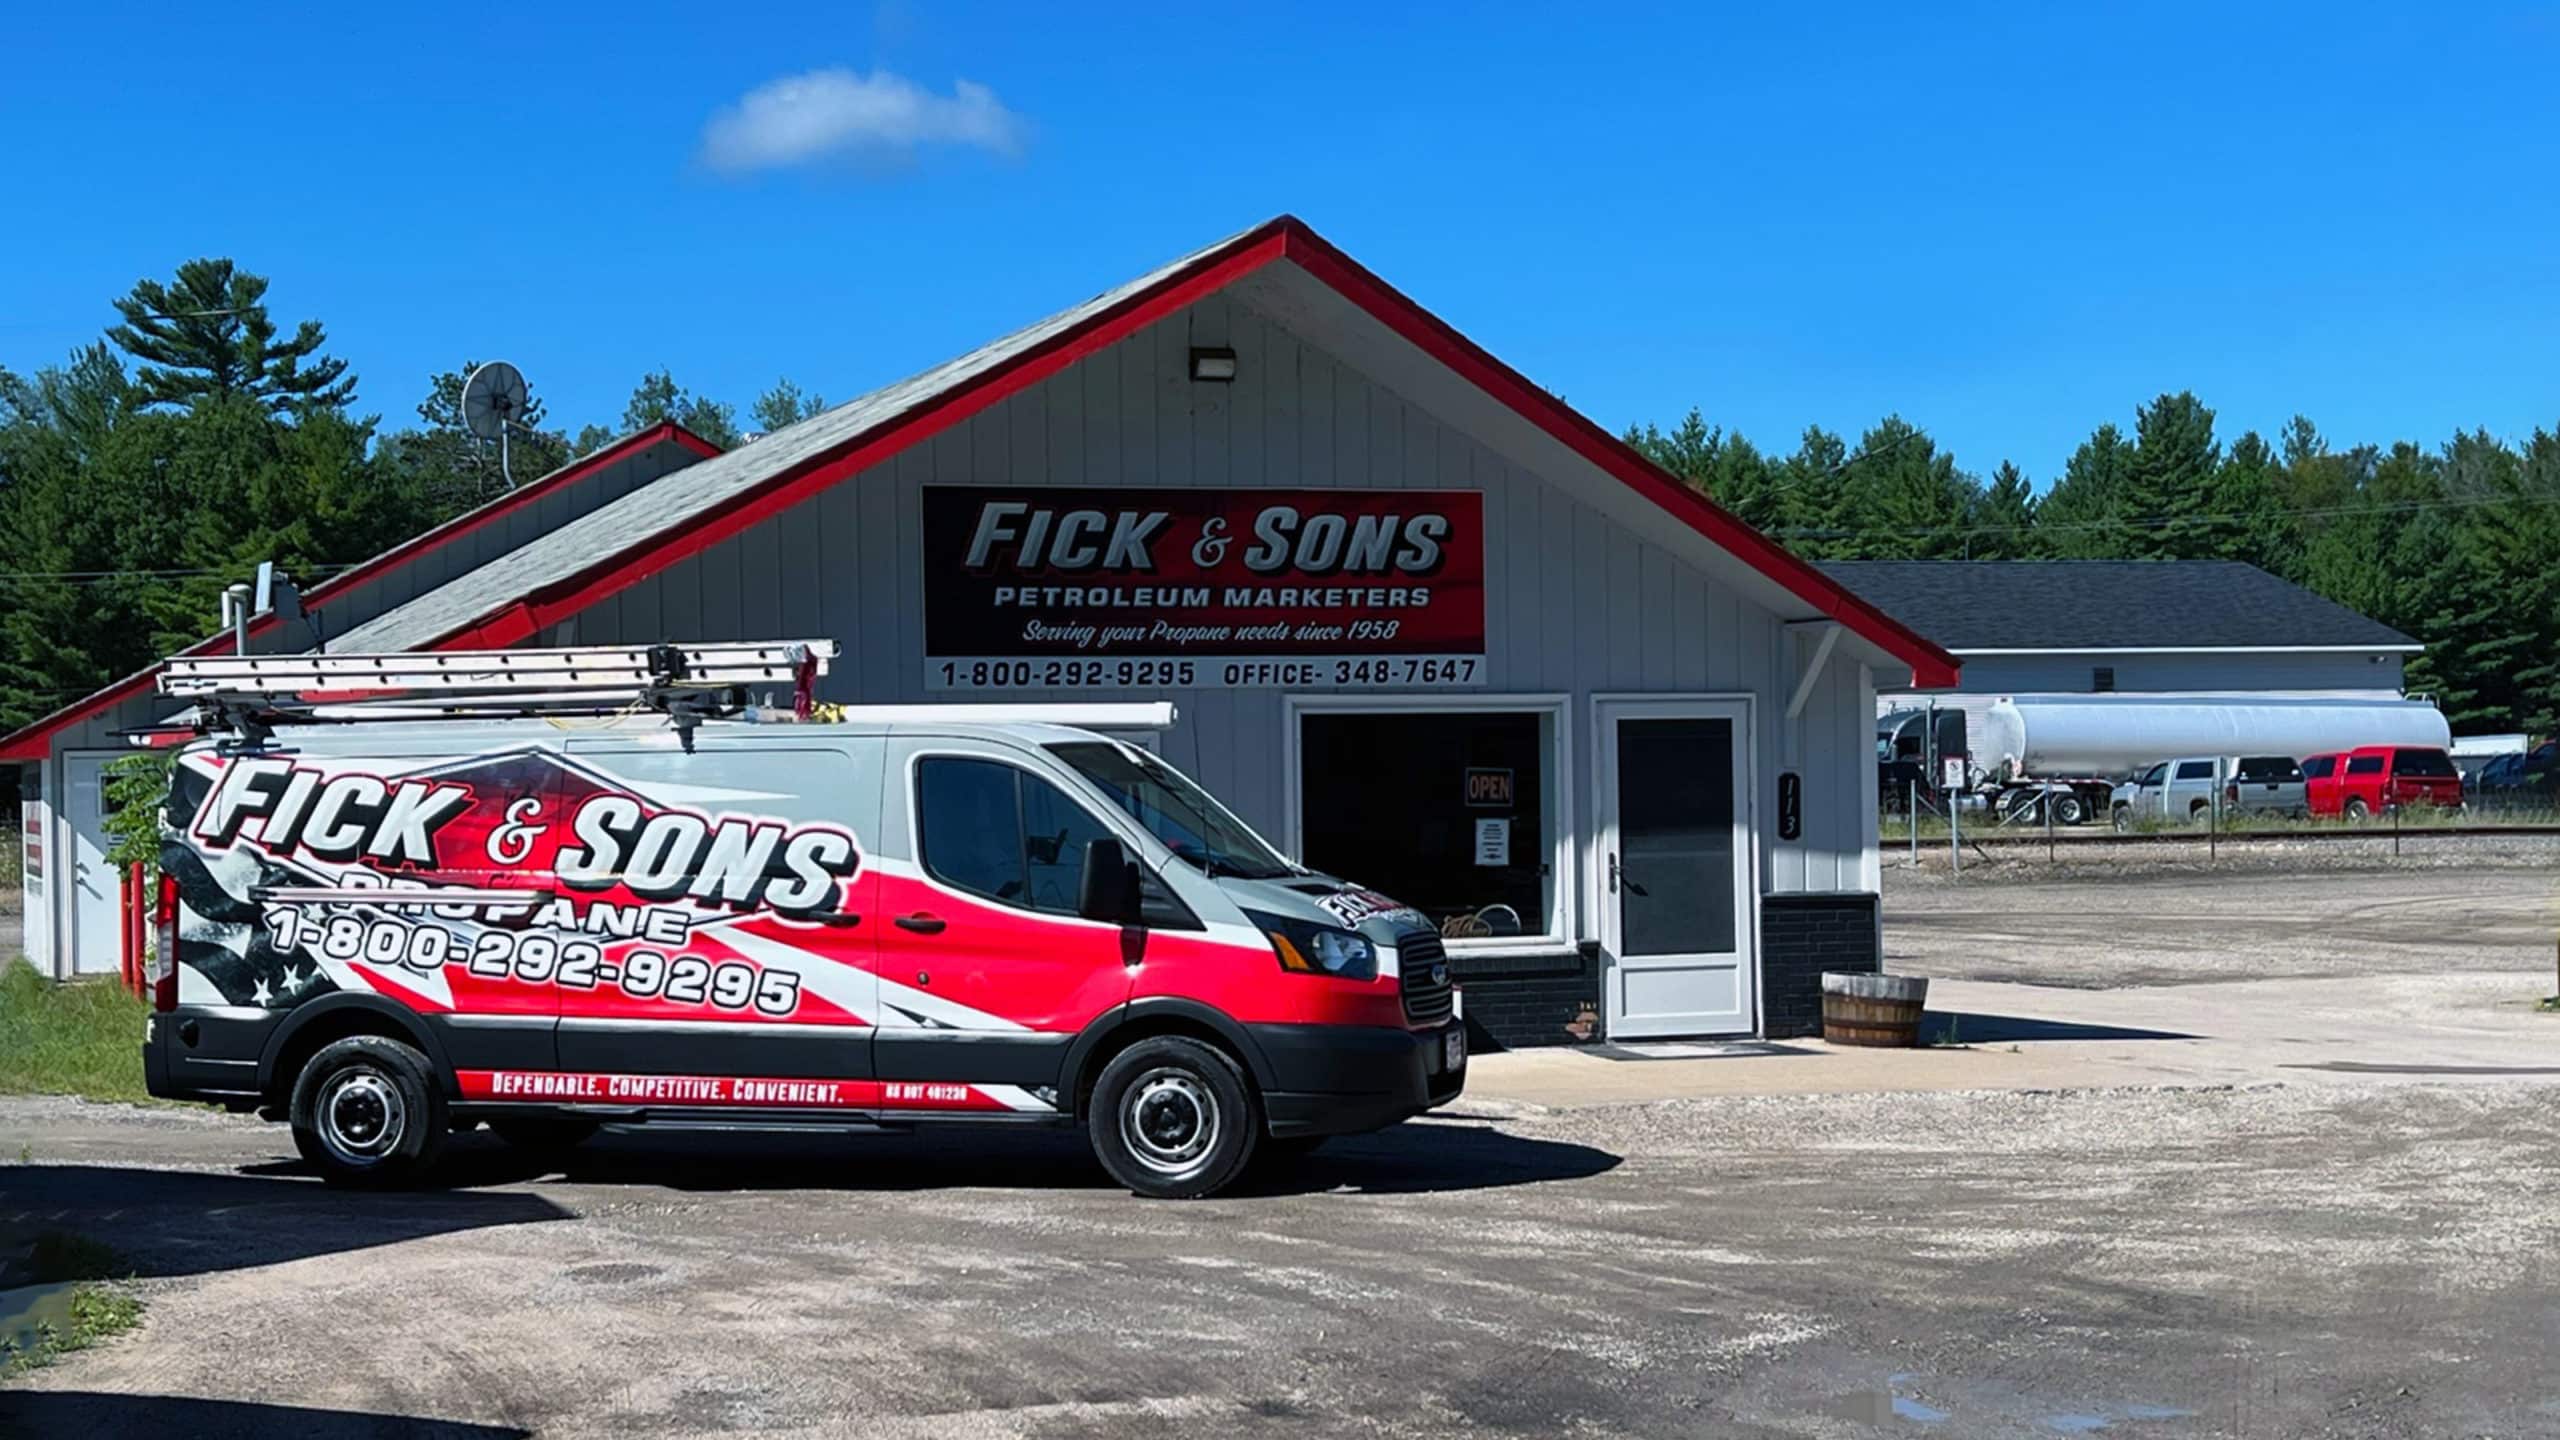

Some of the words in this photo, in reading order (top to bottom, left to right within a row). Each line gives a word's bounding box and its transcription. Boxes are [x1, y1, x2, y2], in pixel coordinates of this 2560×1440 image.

[964, 501, 1169, 569] FICK
[1192, 516, 1233, 568] &
[1243, 505, 1449, 573] SONS
[993, 586, 1211, 608] PETROLEUM
[1223, 587, 1430, 608] MARKETERS
[1022, 619, 1096, 648] Serving
[1098, 626, 1144, 648] your
[1149, 619, 1229, 645] Propane
[1234, 621, 1287, 641] needs
[1295, 621, 1343, 640] since
[1347, 619, 1400, 640] 1958
[941, 661, 1195, 687] 1-800-292-9295
[1224, 663, 1323, 686] OFFICE-
[1335, 658, 1476, 685] 348-7647
[1469, 775, 1510, 800] OPEN
[196, 756, 474, 867] FICK
[486, 797, 547, 865] &
[554, 795, 857, 914] SONS
[264, 906, 801, 1016] 1-800-292-9295
[492, 1073, 602, 1095] DEPENDABLE.
[609, 1076, 726, 1099] COMPETITIVE.
[733, 1079, 844, 1103] CONVENIENT.
